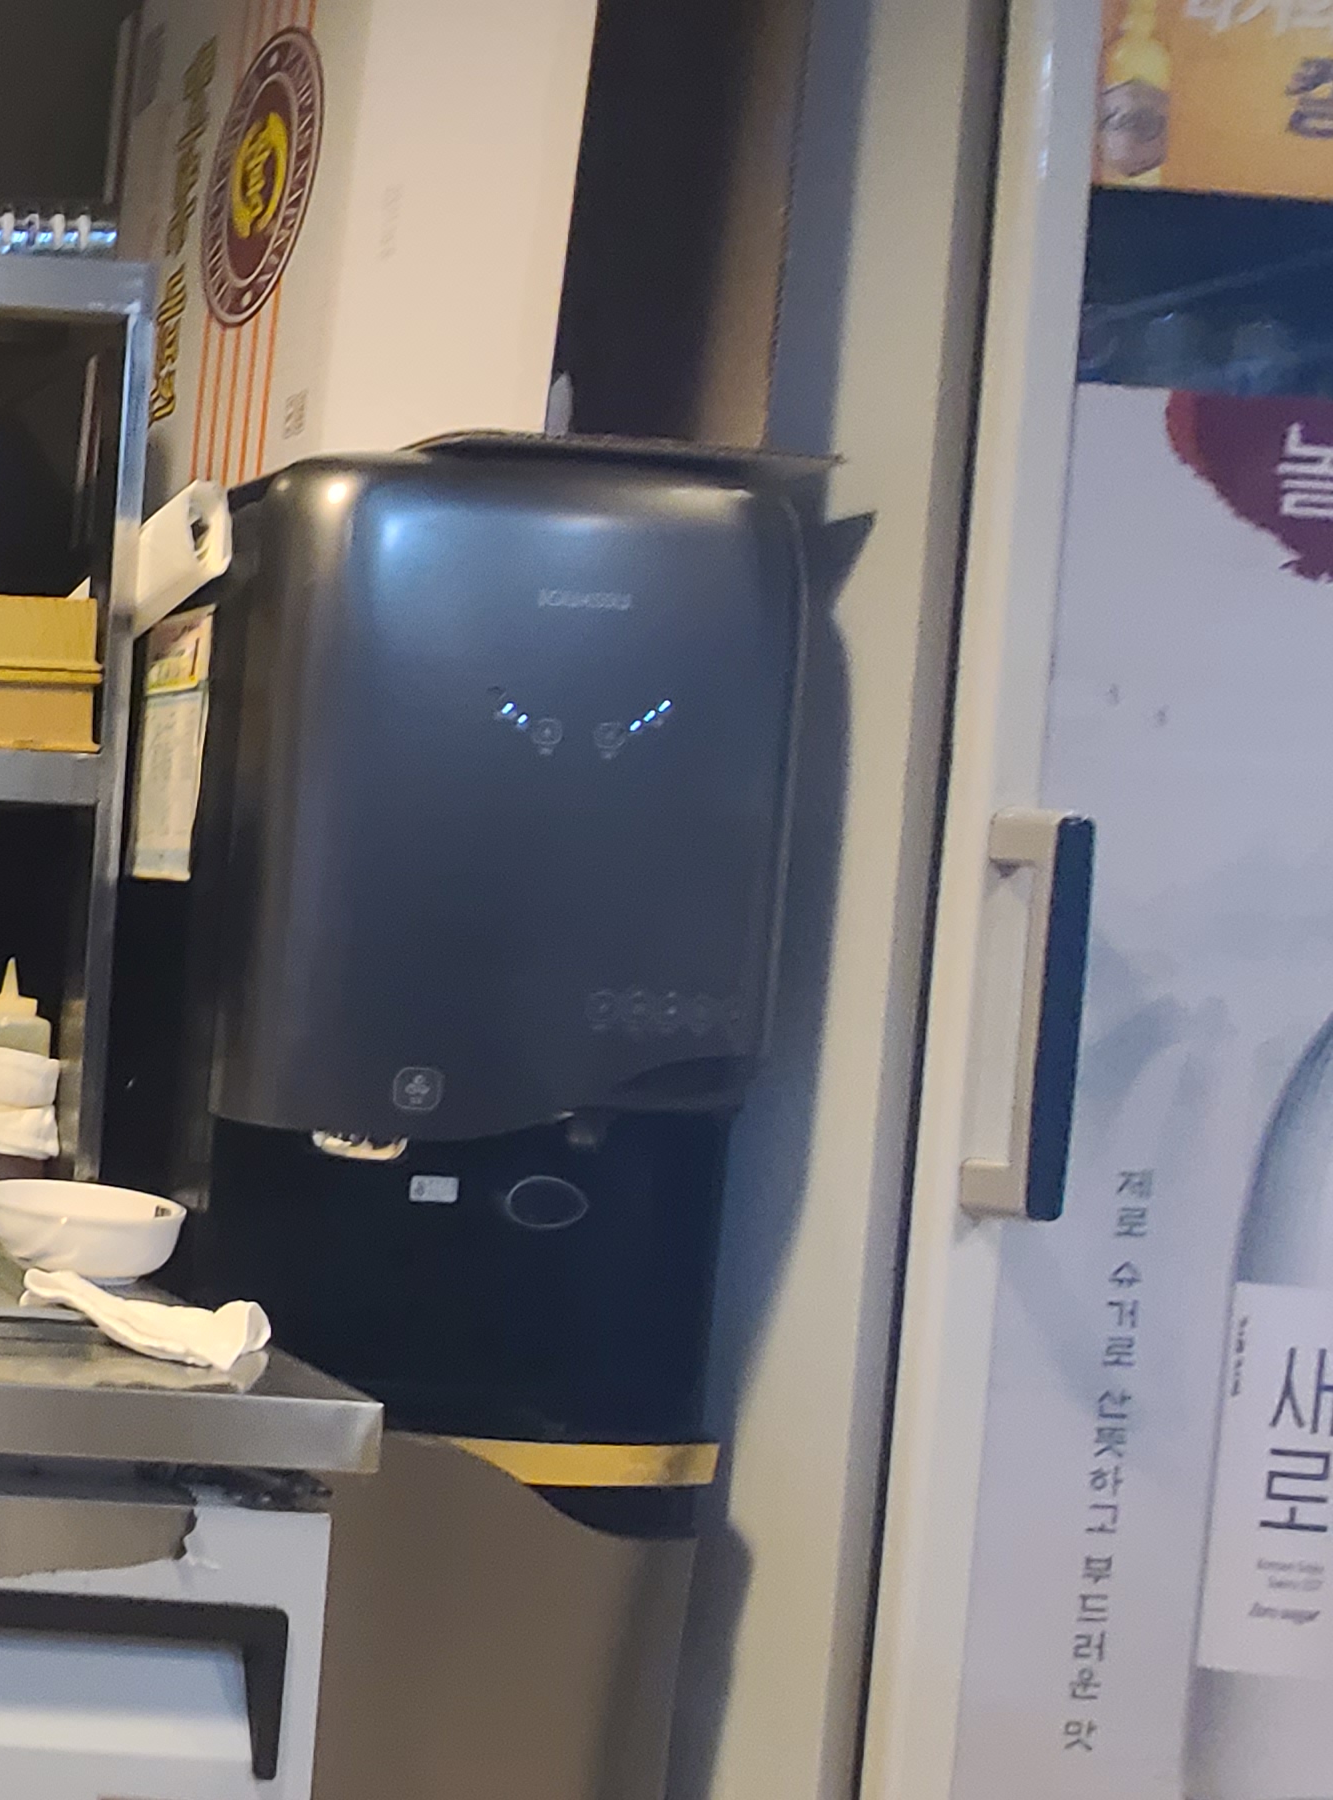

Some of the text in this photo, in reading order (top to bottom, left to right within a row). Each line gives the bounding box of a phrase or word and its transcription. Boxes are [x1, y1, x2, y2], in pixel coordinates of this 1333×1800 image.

[1114, 1168, 1154, 1238] 제로
[1102, 1260, 1142, 1368] 슈거로
[1069, 1554, 1114, 1702] 부드러운
[1063, 1718, 1098, 1752] 맛
